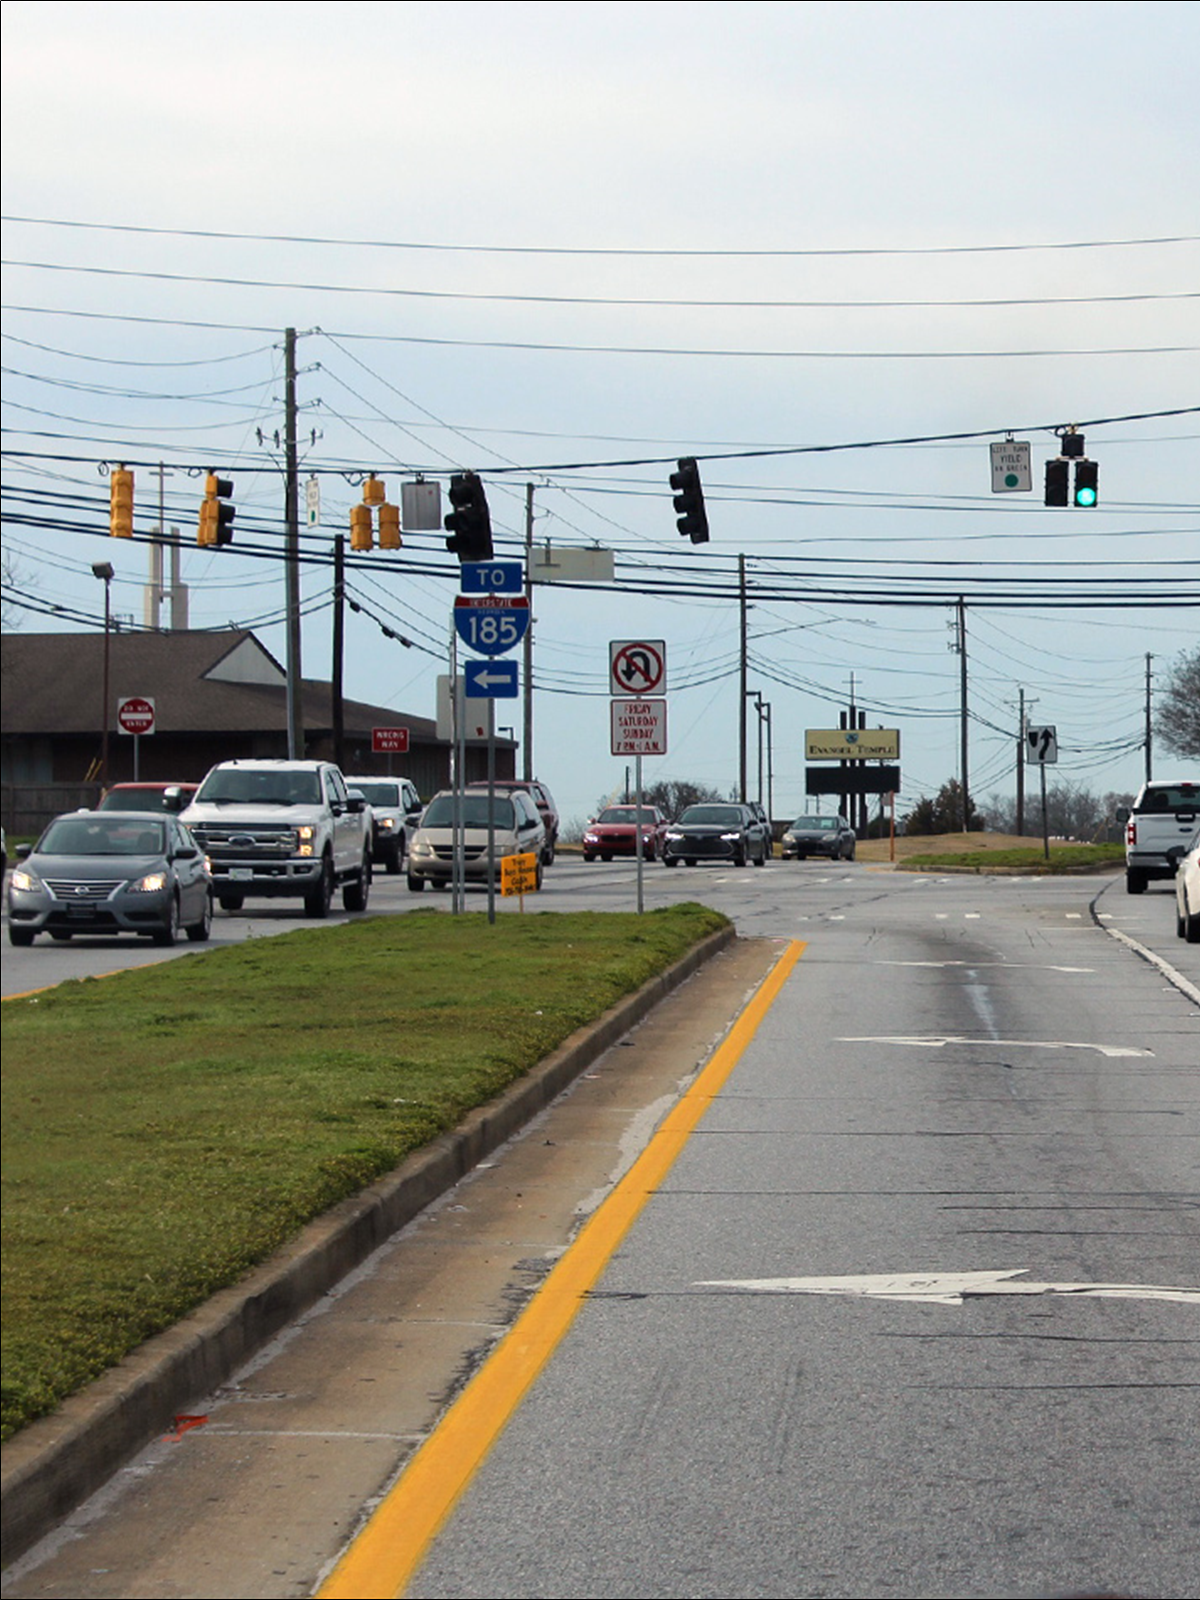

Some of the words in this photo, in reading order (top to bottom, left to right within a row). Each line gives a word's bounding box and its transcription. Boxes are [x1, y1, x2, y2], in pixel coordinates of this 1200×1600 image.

[1001, 454, 1021, 463] YIELD
[476, 569, 505, 586] TO
[469, 616, 517, 644] 185
[625, 704, 651, 714] FRIDAY
[618, 716, 658, 726] SATURDAY
[376, 731, 405, 739] WRONG
[623, 729, 653, 739] SUNDAY
